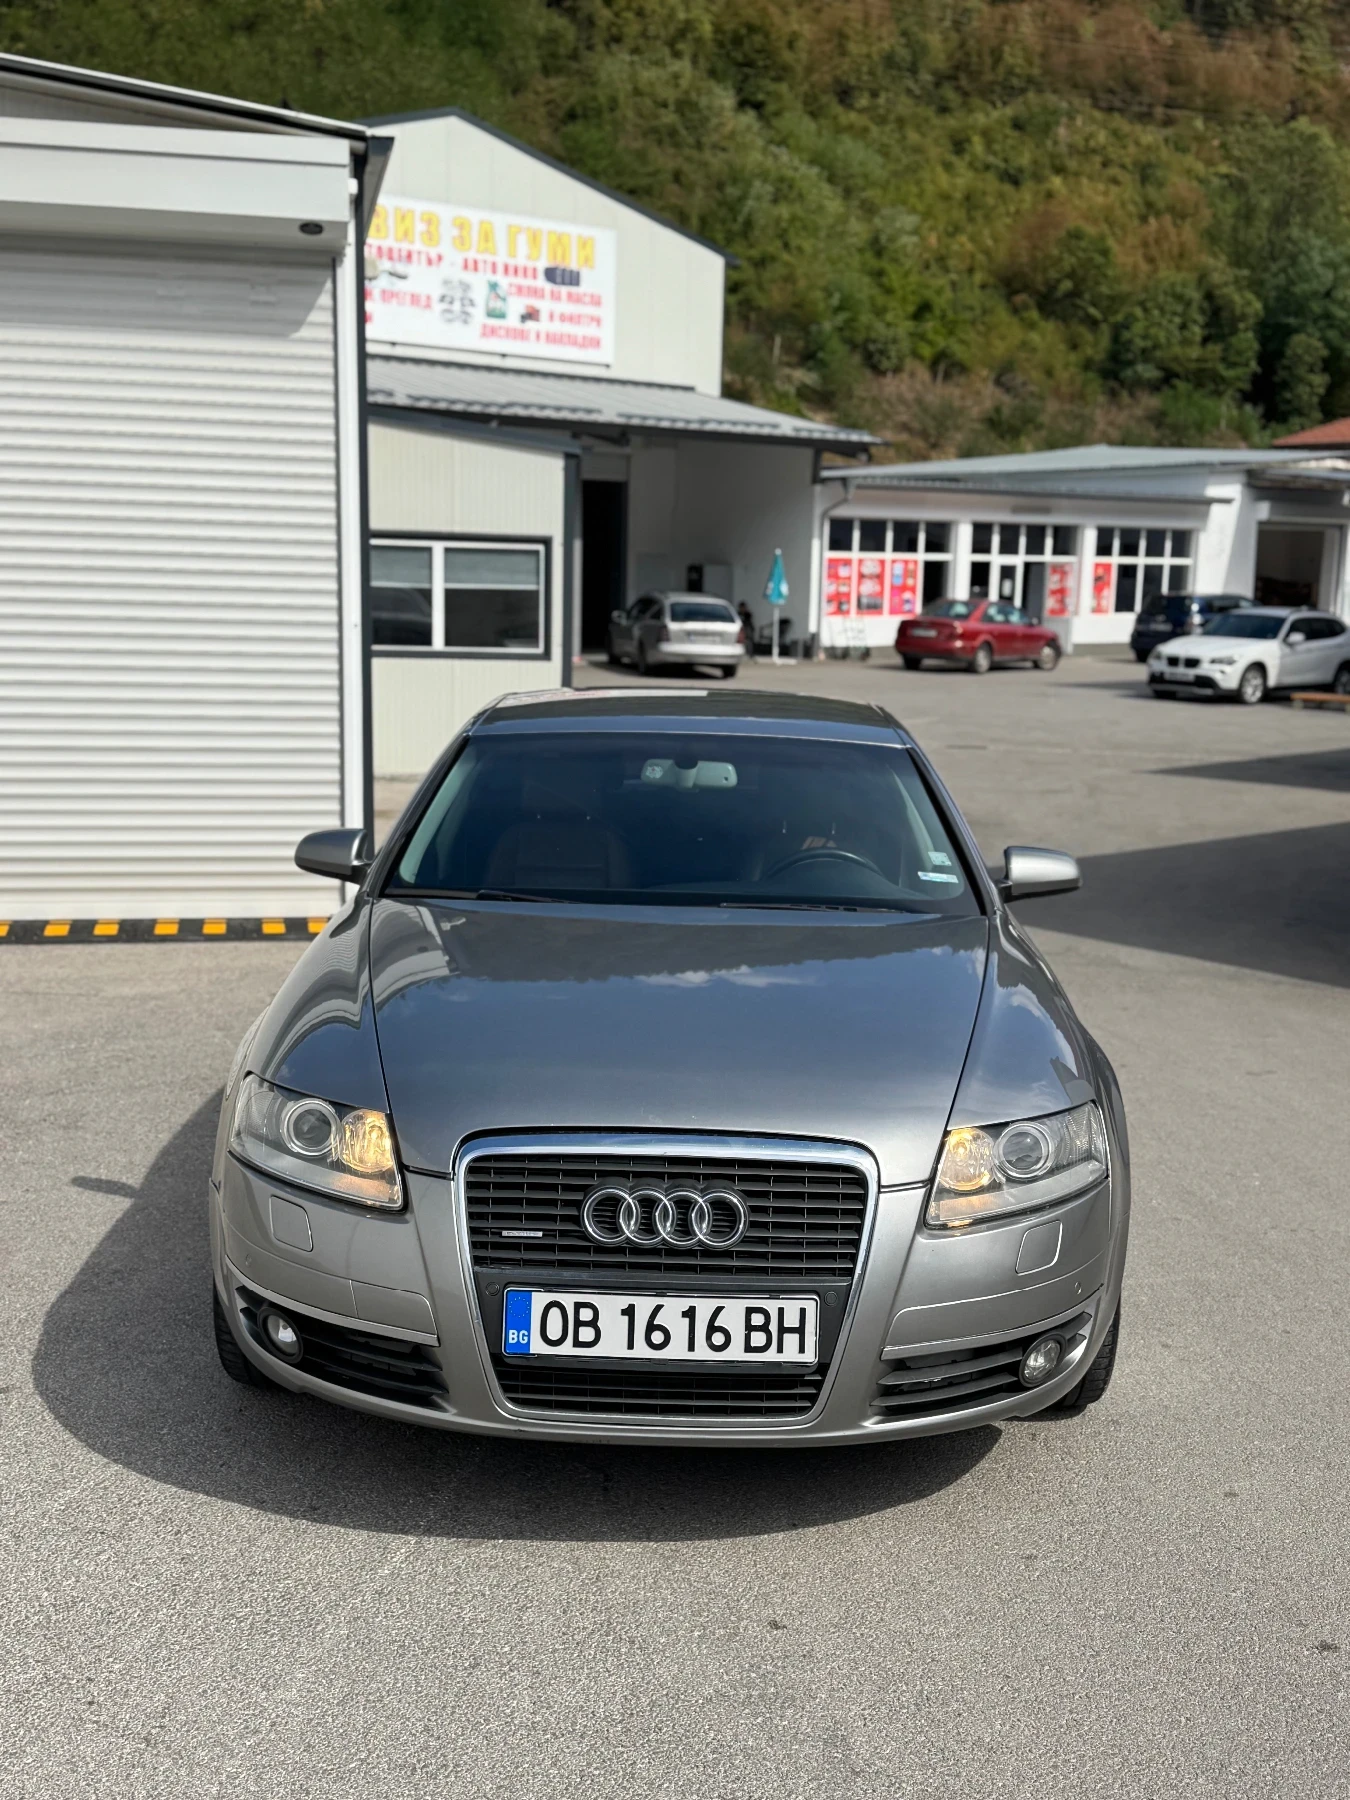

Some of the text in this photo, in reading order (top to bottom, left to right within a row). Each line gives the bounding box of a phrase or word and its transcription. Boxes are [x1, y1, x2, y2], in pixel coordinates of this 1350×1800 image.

[451, 215, 497, 256] ЗА
[507, 224, 596, 270] ГУМИ
[461, 257, 498, 276] АВТО
[508, 1329, 529, 1344] BG
[539, 1300, 807, 1354] OB 1616 BH
